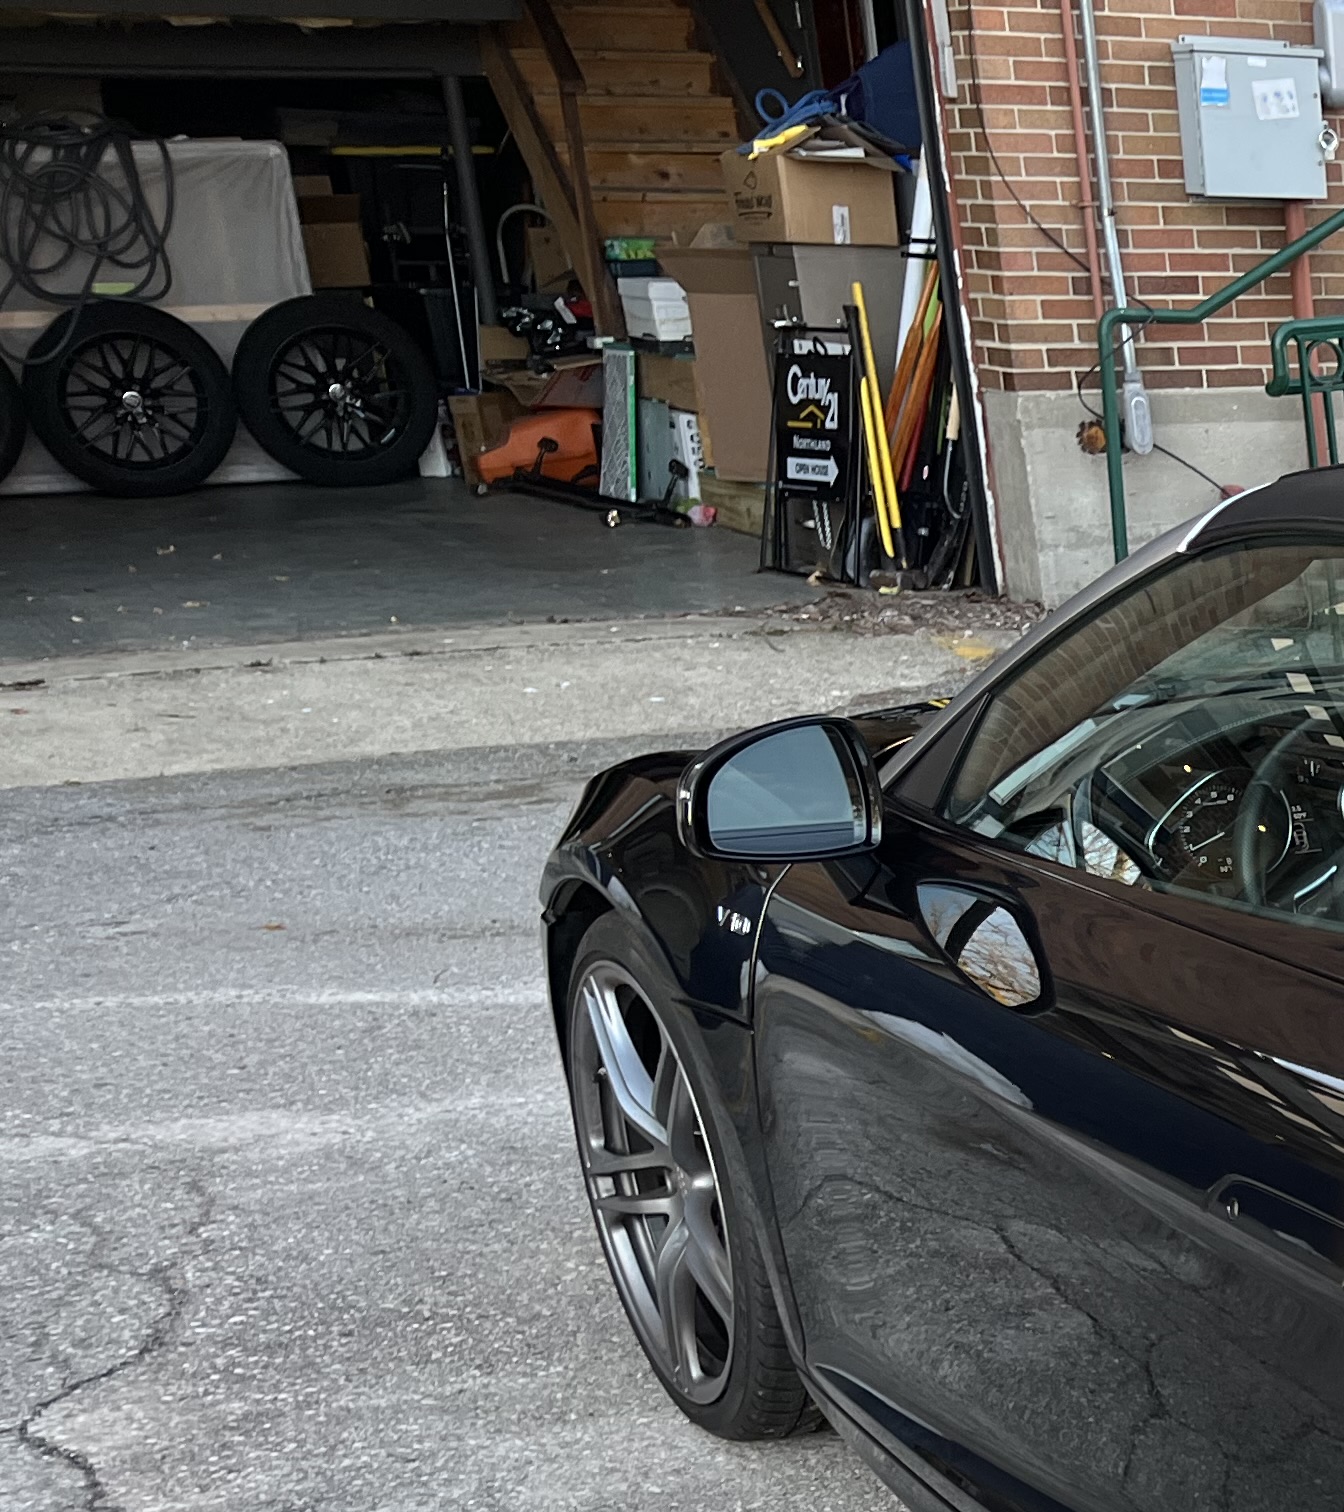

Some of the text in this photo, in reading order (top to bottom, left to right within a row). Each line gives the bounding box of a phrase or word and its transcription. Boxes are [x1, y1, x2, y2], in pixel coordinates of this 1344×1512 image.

[787, 364, 831, 406] Century
[825, 392, 839, 430] 21
[795, 462, 829, 476] OPEN HOUSE
